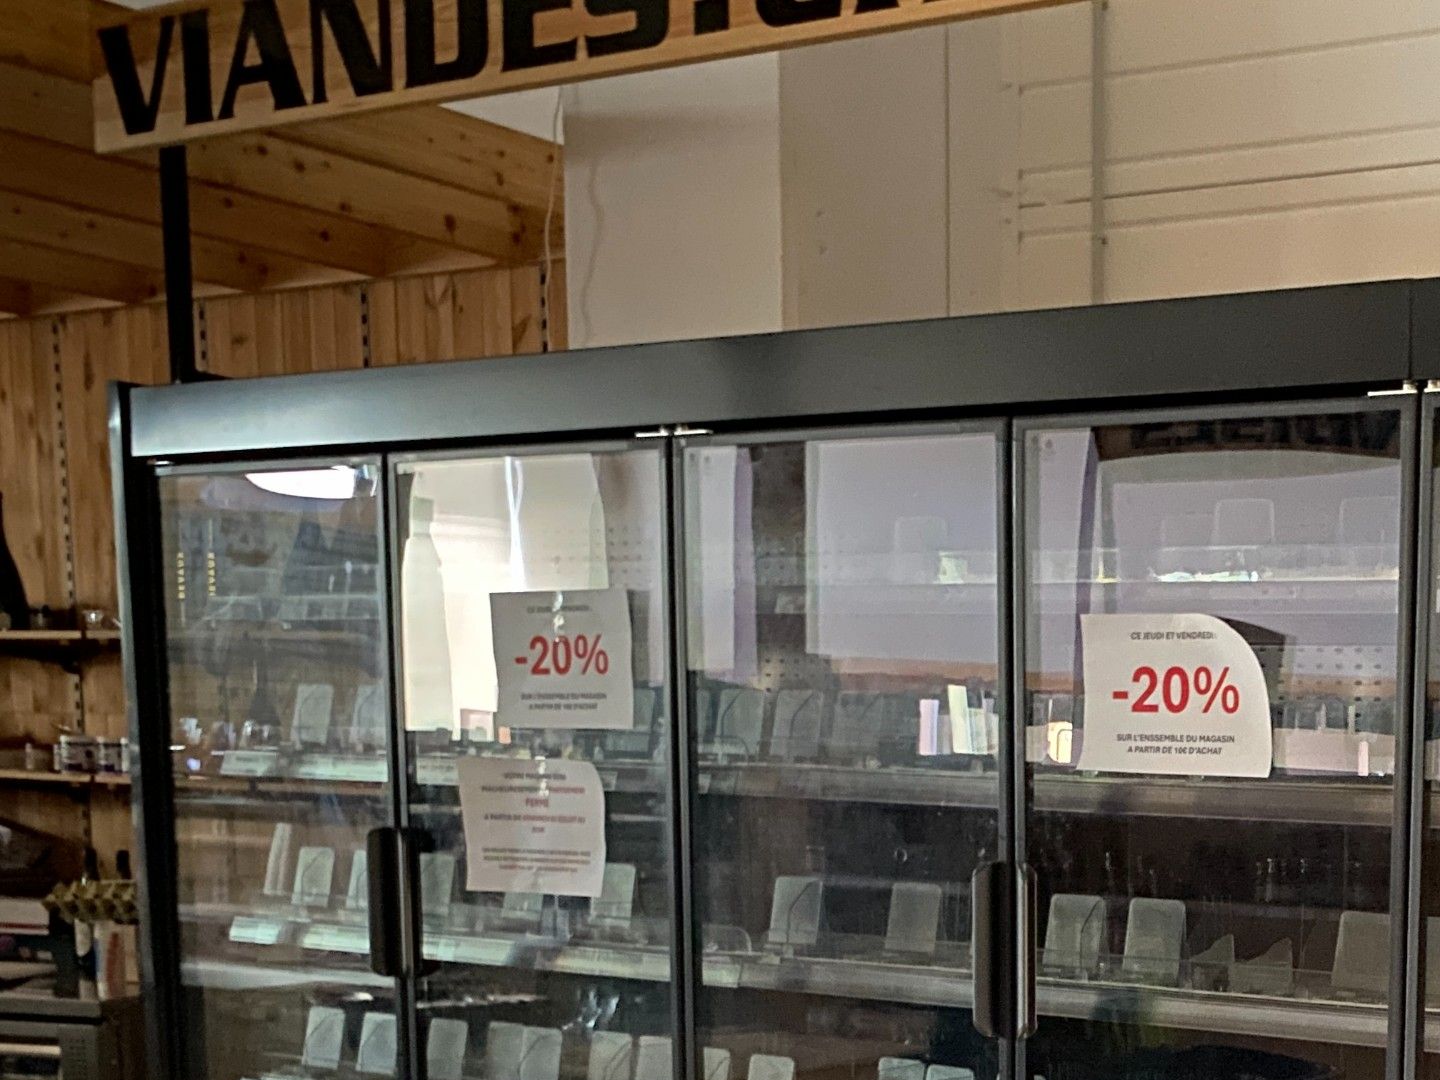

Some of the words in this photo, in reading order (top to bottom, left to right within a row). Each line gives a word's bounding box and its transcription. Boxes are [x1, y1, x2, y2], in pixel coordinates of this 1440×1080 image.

[514, 633, 609, 675] -20%
[1112, 666, 1240, 714] -20%
[1117, 733, 1132, 741] SUR
[1186, 734, 1197, 742] DU
[1199, 735, 1235, 743] MAGASIN
[1162, 746, 1172, 754] DE
